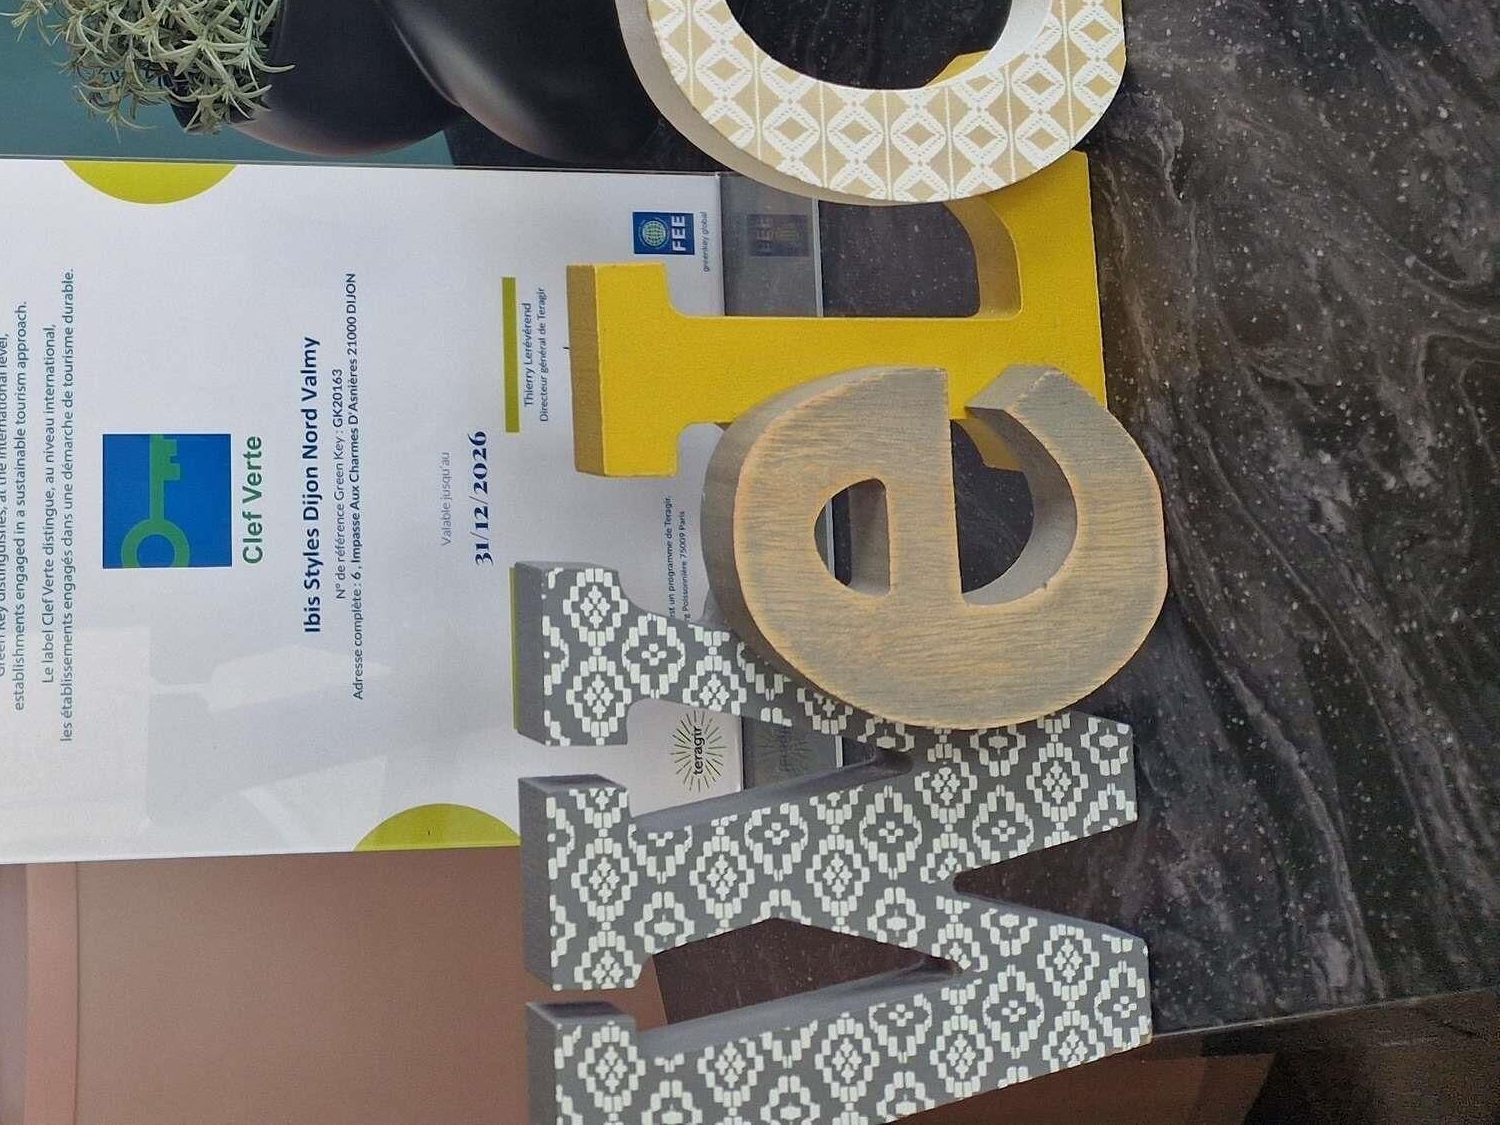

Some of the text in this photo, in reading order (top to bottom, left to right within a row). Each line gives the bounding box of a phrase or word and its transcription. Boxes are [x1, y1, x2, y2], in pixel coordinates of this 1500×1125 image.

[671, 214, 687, 252] FEE
[331, 369, 343, 428] GK20163
[521, 303, 535, 408] Thierry Lerévérend
[536, 288, 549, 423] Directeur général de Teragir
[241, 437, 263, 564] Clef Verte
[299, 337, 323, 633] Ibis Styles Dijon Nord Valmy
[332, 437, 345, 461] Key
[333, 463, 344, 502] Green
[345, 274, 363, 700] Adresse complète 6 Impasse Aux Charmes D'Asnières 21000 DIJON
[437, 452, 452, 548] Valable jusqu'au
[467, 432, 493, 566] 31/12/2026
[11, 302, 29, 711] establishments engaged in a sustainable tourism approach.
[40, 325, 57, 684] Le label Clef Verte distingue, au niveau international,
[59, 269, 76, 742] les établissements engagés dans une démarche de tourisme durable.
[334, 504, 345, 563] référence
[334, 565, 346, 581] de
[689, 726, 706, 776] teragir
